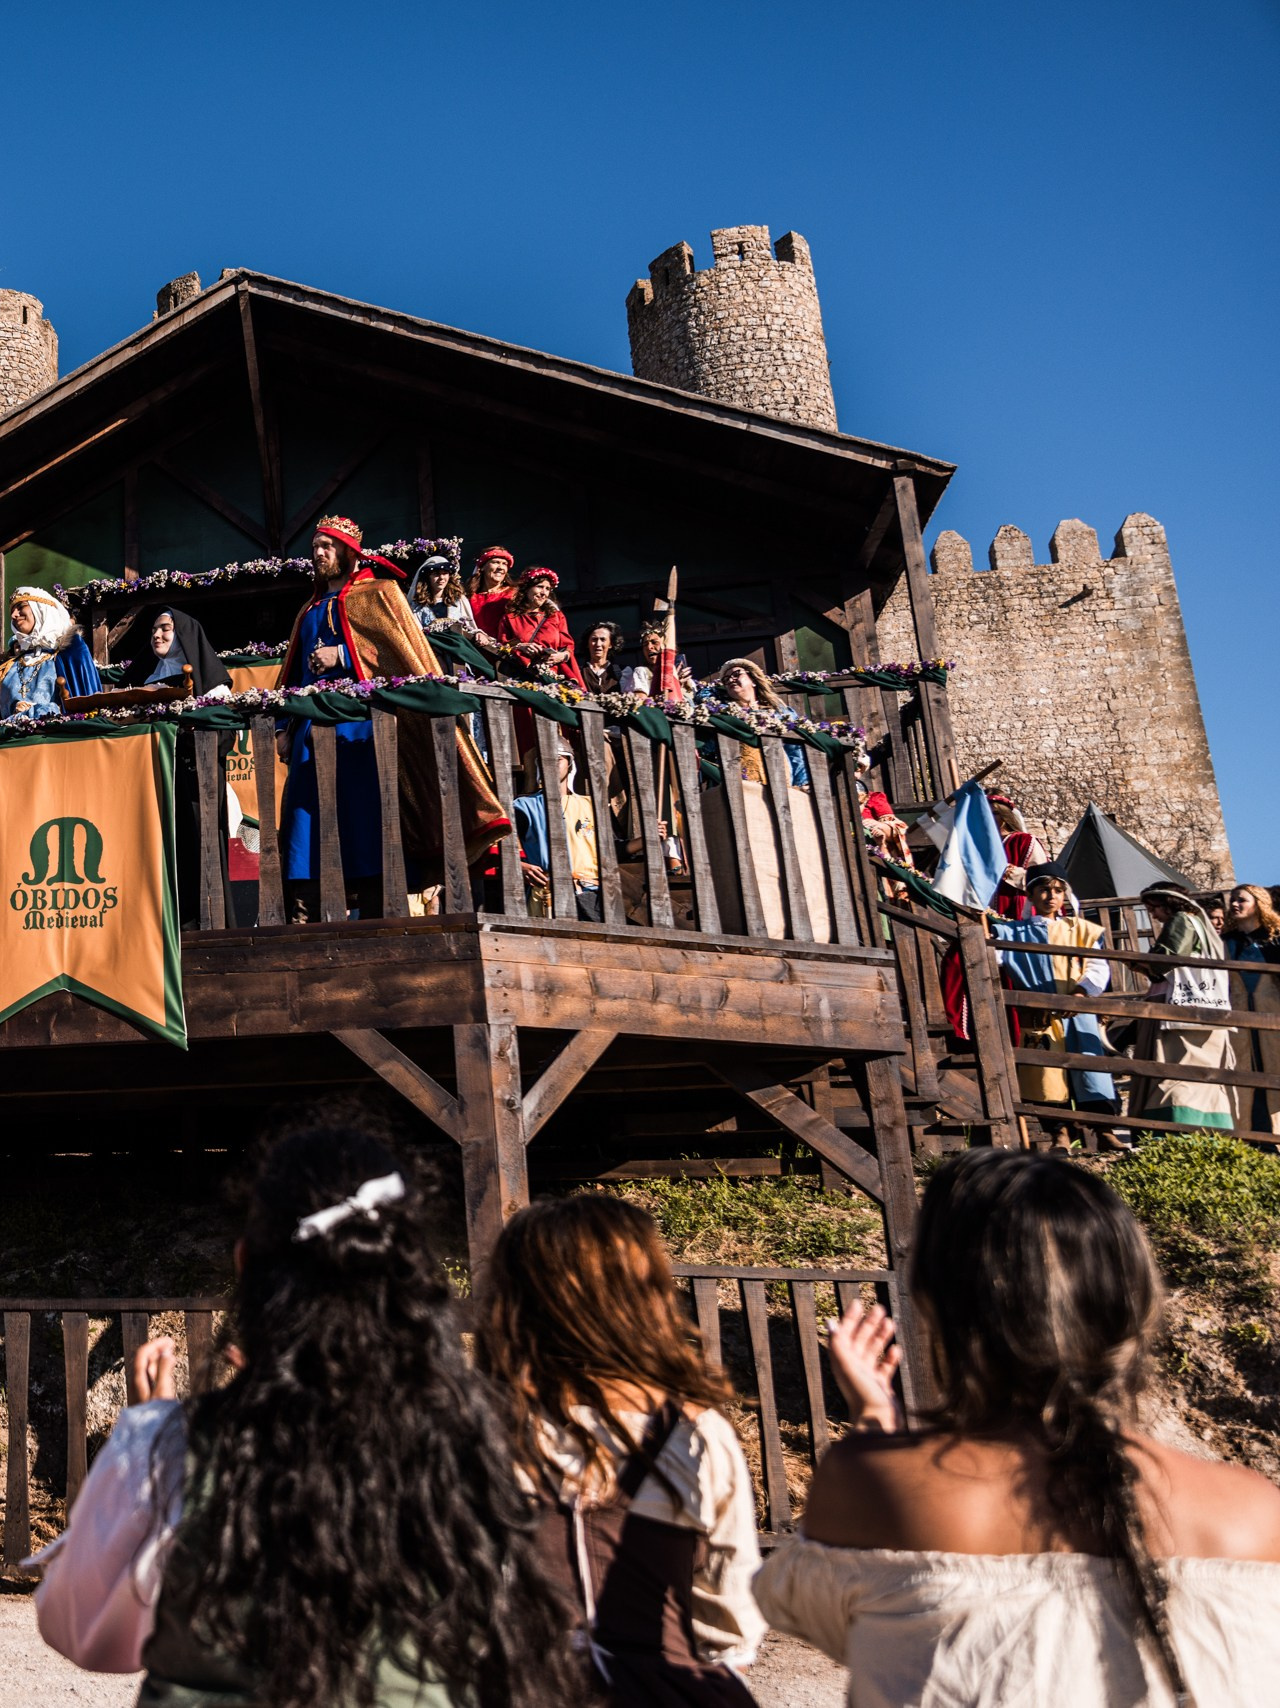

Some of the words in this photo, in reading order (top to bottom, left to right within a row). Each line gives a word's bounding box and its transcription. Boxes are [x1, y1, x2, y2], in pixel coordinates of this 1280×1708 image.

[226, 757, 255, 772] DOS
[227, 771, 251, 781] ieval
[10, 883, 118, 913] ÓBIDOS
[22, 910, 104, 930] Medieval
